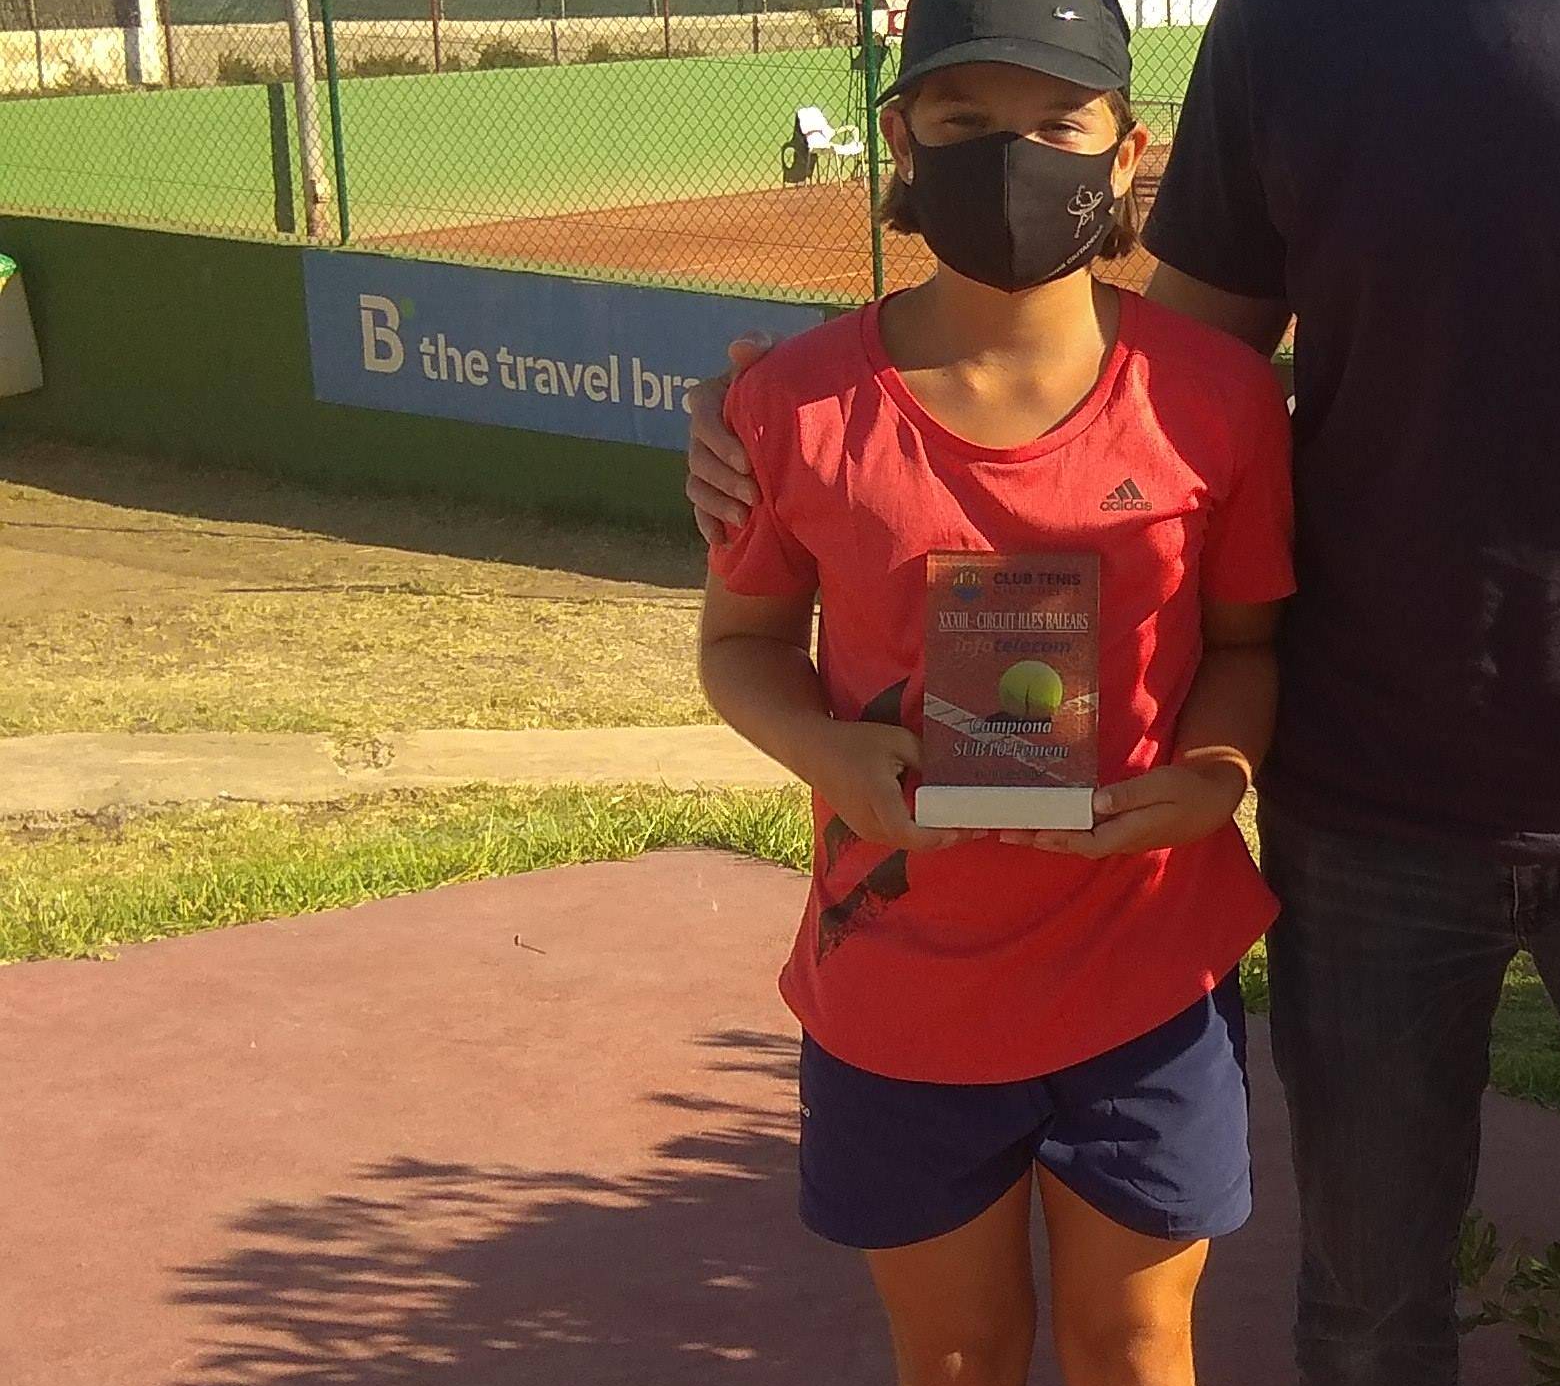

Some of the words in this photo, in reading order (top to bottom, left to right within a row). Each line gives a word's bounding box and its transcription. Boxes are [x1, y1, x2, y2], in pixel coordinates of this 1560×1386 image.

[359, 293, 404, 373] B
[419, 333, 489, 387] the
[496, 346, 621, 403] travel
[1099, 498, 1153, 512] adidas
[993, 572, 1032, 586] CLUB
[1036, 572, 1081, 587] TENIS
[976, 612, 1016, 630] CIRCUIT
[1018, 612, 1044, 630] ILLES
[1045, 612, 1089, 631] BALEARS
[970, 717, 1053, 736] Campiona
